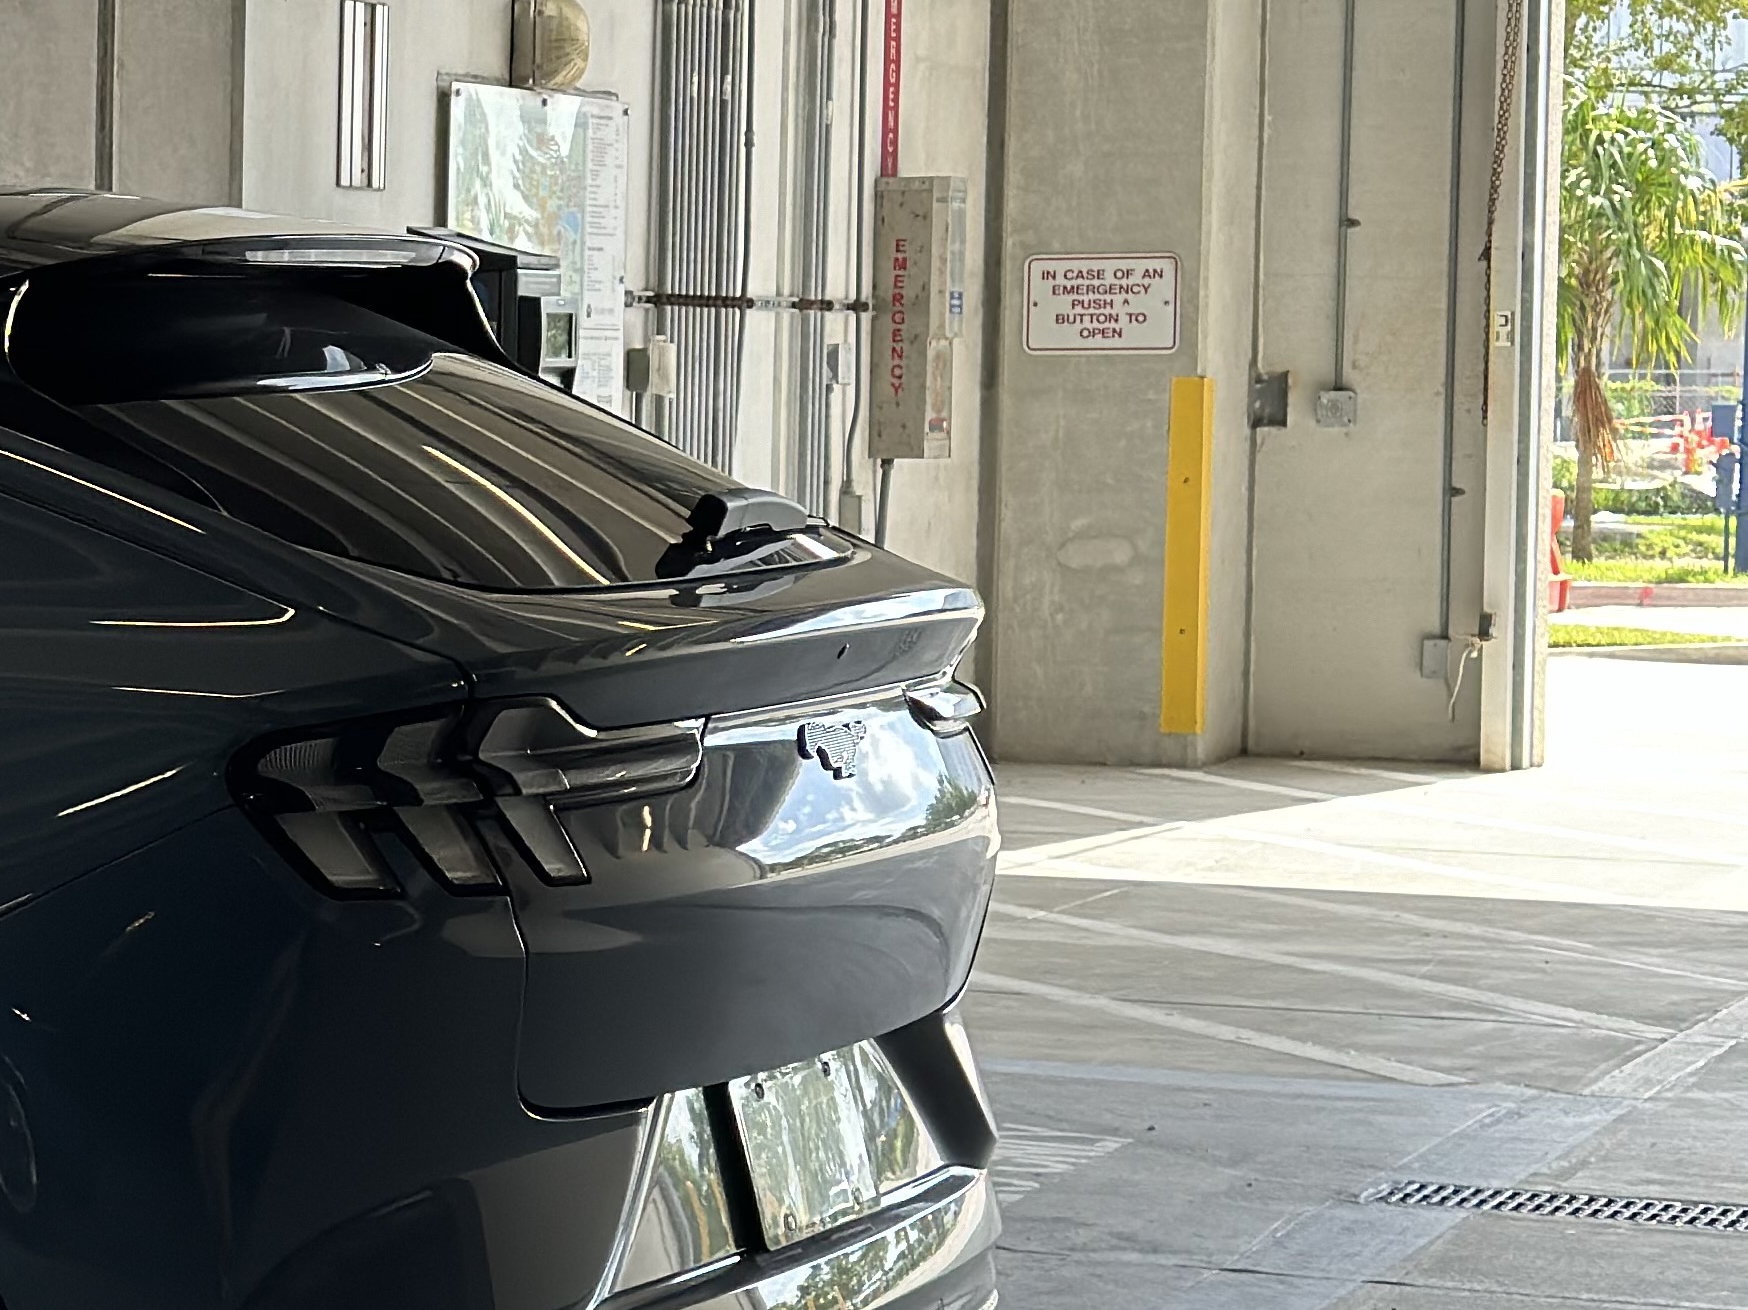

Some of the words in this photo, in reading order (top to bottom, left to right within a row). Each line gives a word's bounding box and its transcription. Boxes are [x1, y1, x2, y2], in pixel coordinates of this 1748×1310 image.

[1041, 269, 1056, 281] IN
[1063, 269, 1106, 281] CASE
[1113, 268, 1135, 279] OF
[1142, 268, 1164, 279] AN
[1052, 283, 1151, 296] EMERGENCY
[1071, 299, 1114, 310] PUSH
[891, 239, 907, 398] EMERGENCY
[1055, 313, 1119, 325] BUTTON
[1126, 312, 1147, 324] TO
[1080, 327, 1123, 339] OPEN
